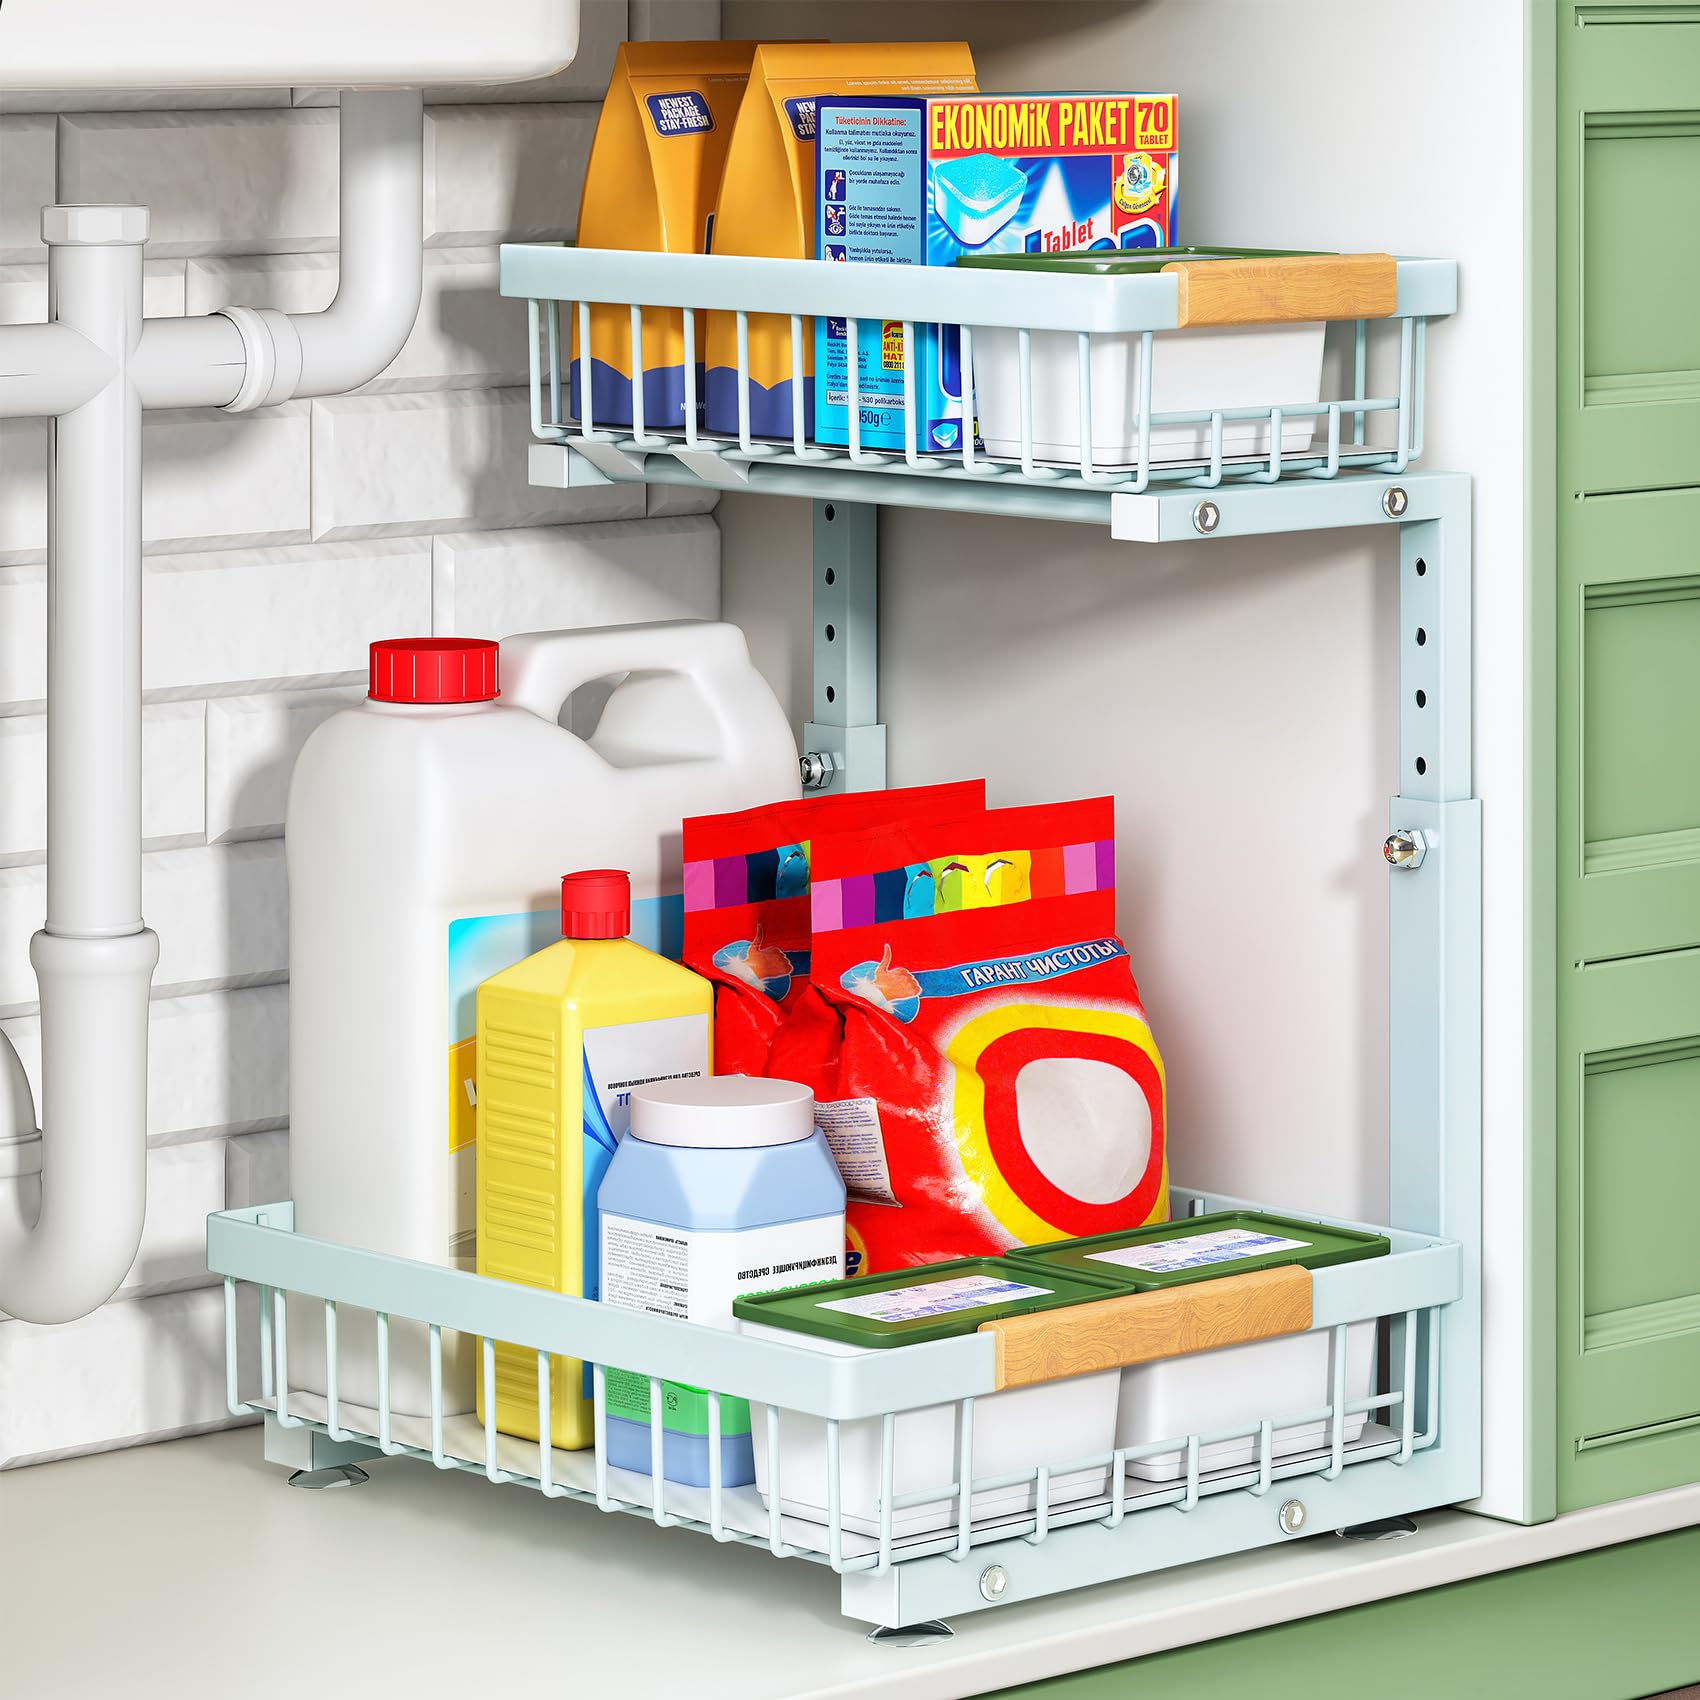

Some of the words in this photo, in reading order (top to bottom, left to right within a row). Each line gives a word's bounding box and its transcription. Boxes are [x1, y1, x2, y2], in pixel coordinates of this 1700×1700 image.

[658, 96, 695, 109] NEWEST
[796, 101, 816, 113] NEW
[661, 106, 701, 119] PACKAGE
[799, 112, 816, 123] PAC
[1138, 101, 1168, 133] 70
[660, 116, 710, 131] STAY-FRESH
[835, 116, 870, 125] Tüketicinin
[872, 117, 906, 126] Dikkatine:
[1059, 101, 1129, 147] PAKET
[1139, 134, 1168, 145] TABLET
[1044, 218, 1093, 252] Tablet
[961, 962, 1026, 987] ГАРАНТ
[1026, 940, 1118, 975] ЧИСТОТЫ
